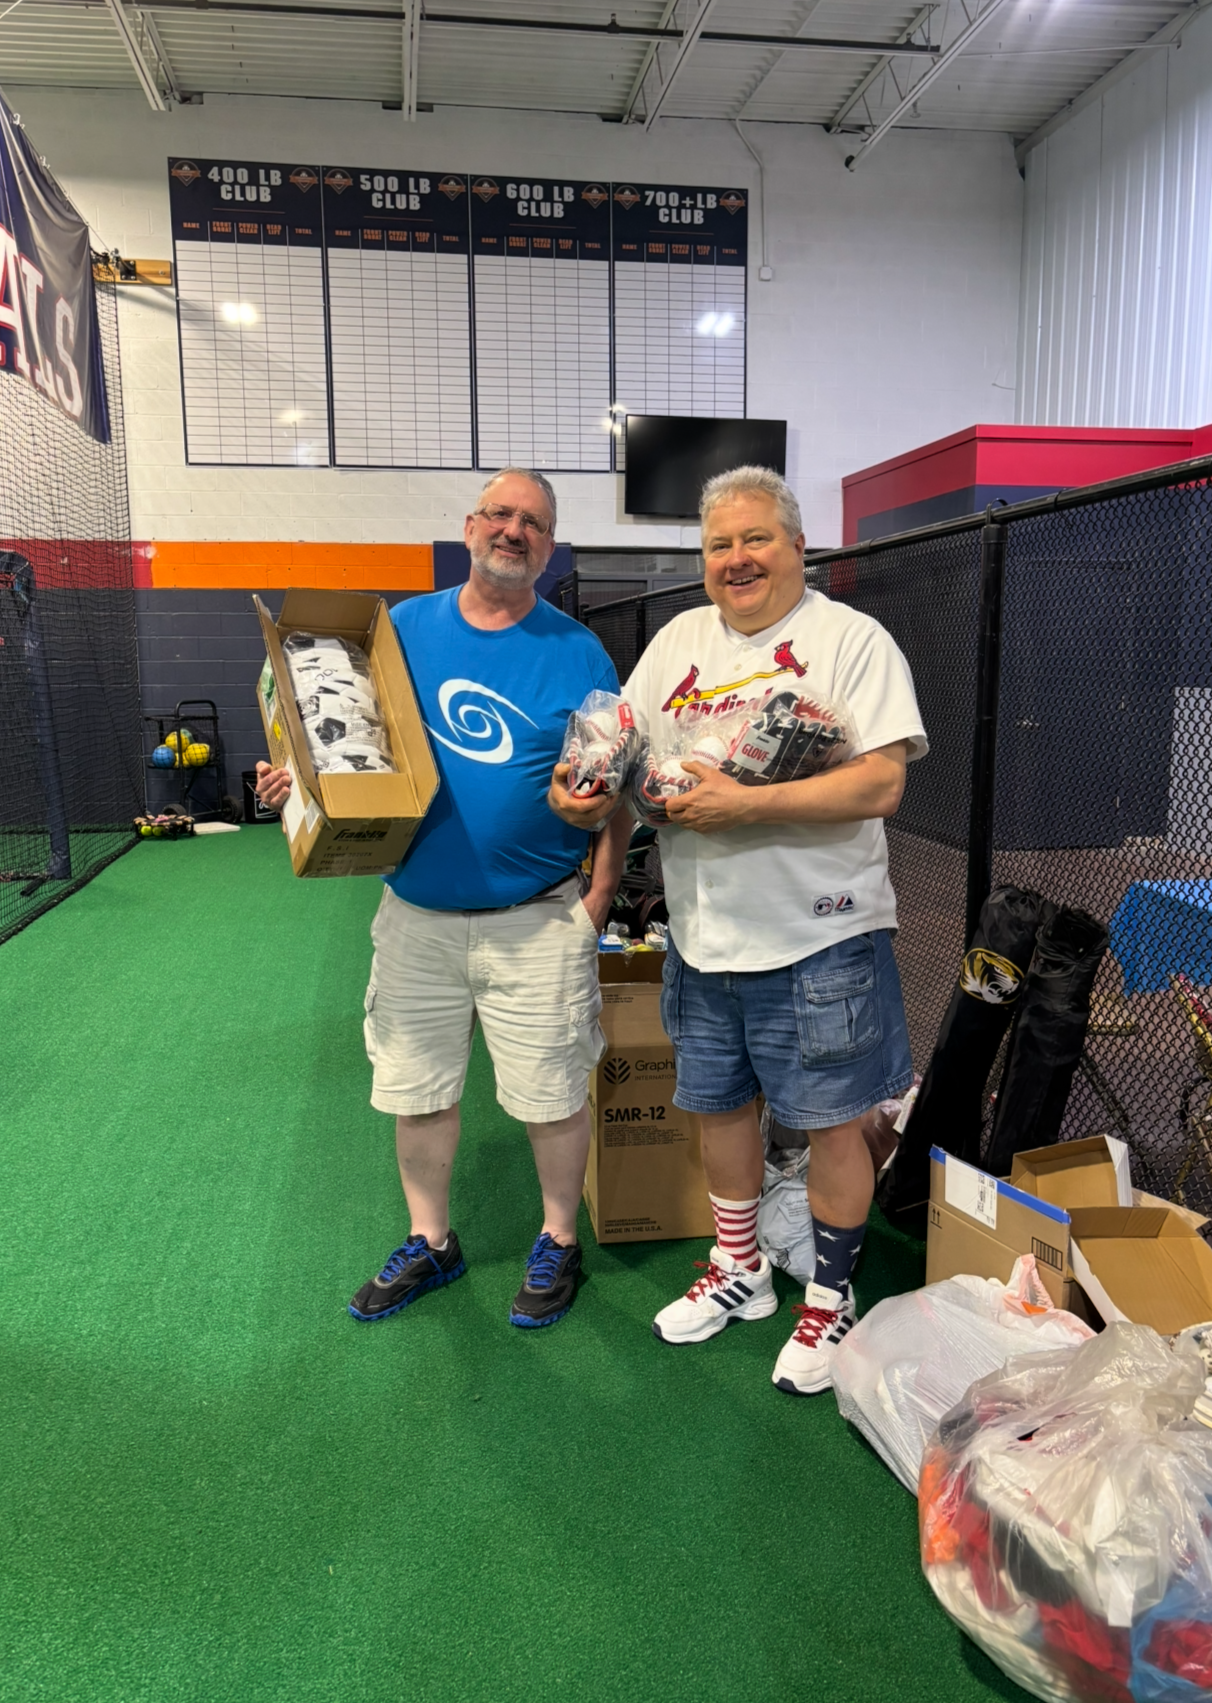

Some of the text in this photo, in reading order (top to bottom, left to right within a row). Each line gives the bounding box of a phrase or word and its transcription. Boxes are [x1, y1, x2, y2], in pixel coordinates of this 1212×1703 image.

[208, 166, 248, 184] 400
[259, 168, 282, 186] LB
[360, 174, 399, 192] 500
[408, 177, 431, 194] LB
[220, 184, 272, 202] CLUB
[372, 192, 421, 210] CLUB
[506, 183, 544, 200] 600
[553, 186, 574, 202] LB
[517, 201, 564, 218] CLUB
[658, 208, 704, 224] CLUB
[741, 743, 770, 762] GLOVE
[333, 829, 387, 840] Franklin
[604, 1106, 666, 1123] SMR-12
[812, 1292, 827, 1300] adidas
